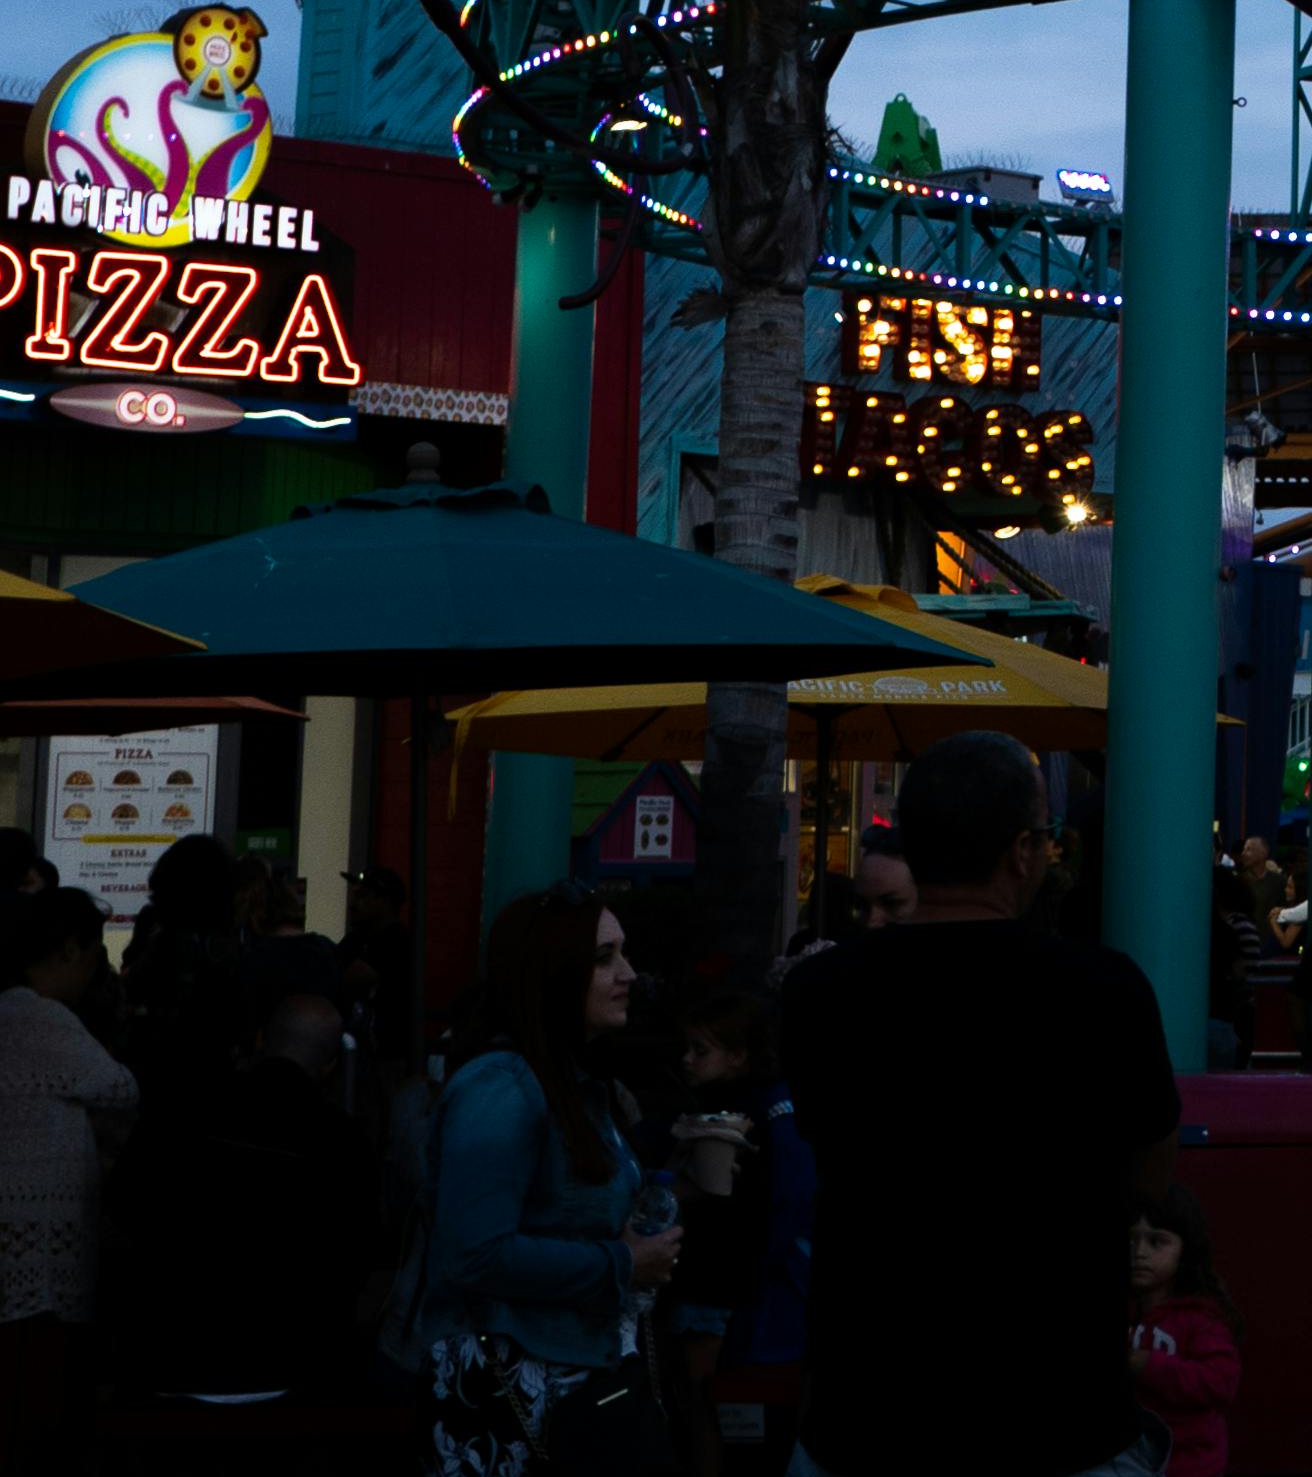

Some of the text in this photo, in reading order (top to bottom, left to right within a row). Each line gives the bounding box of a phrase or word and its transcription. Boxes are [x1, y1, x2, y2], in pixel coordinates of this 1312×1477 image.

[7, 175, 320, 252] PACIFIC WHEEL
[845, 294, 1041, 393] FISH
[116, 390, 186, 427] CO.
[803, 382, 1095, 502] TACOS
[787, 678, 1008, 693] ACIFIC PARK
[115, 748, 153, 760] PIZZA
